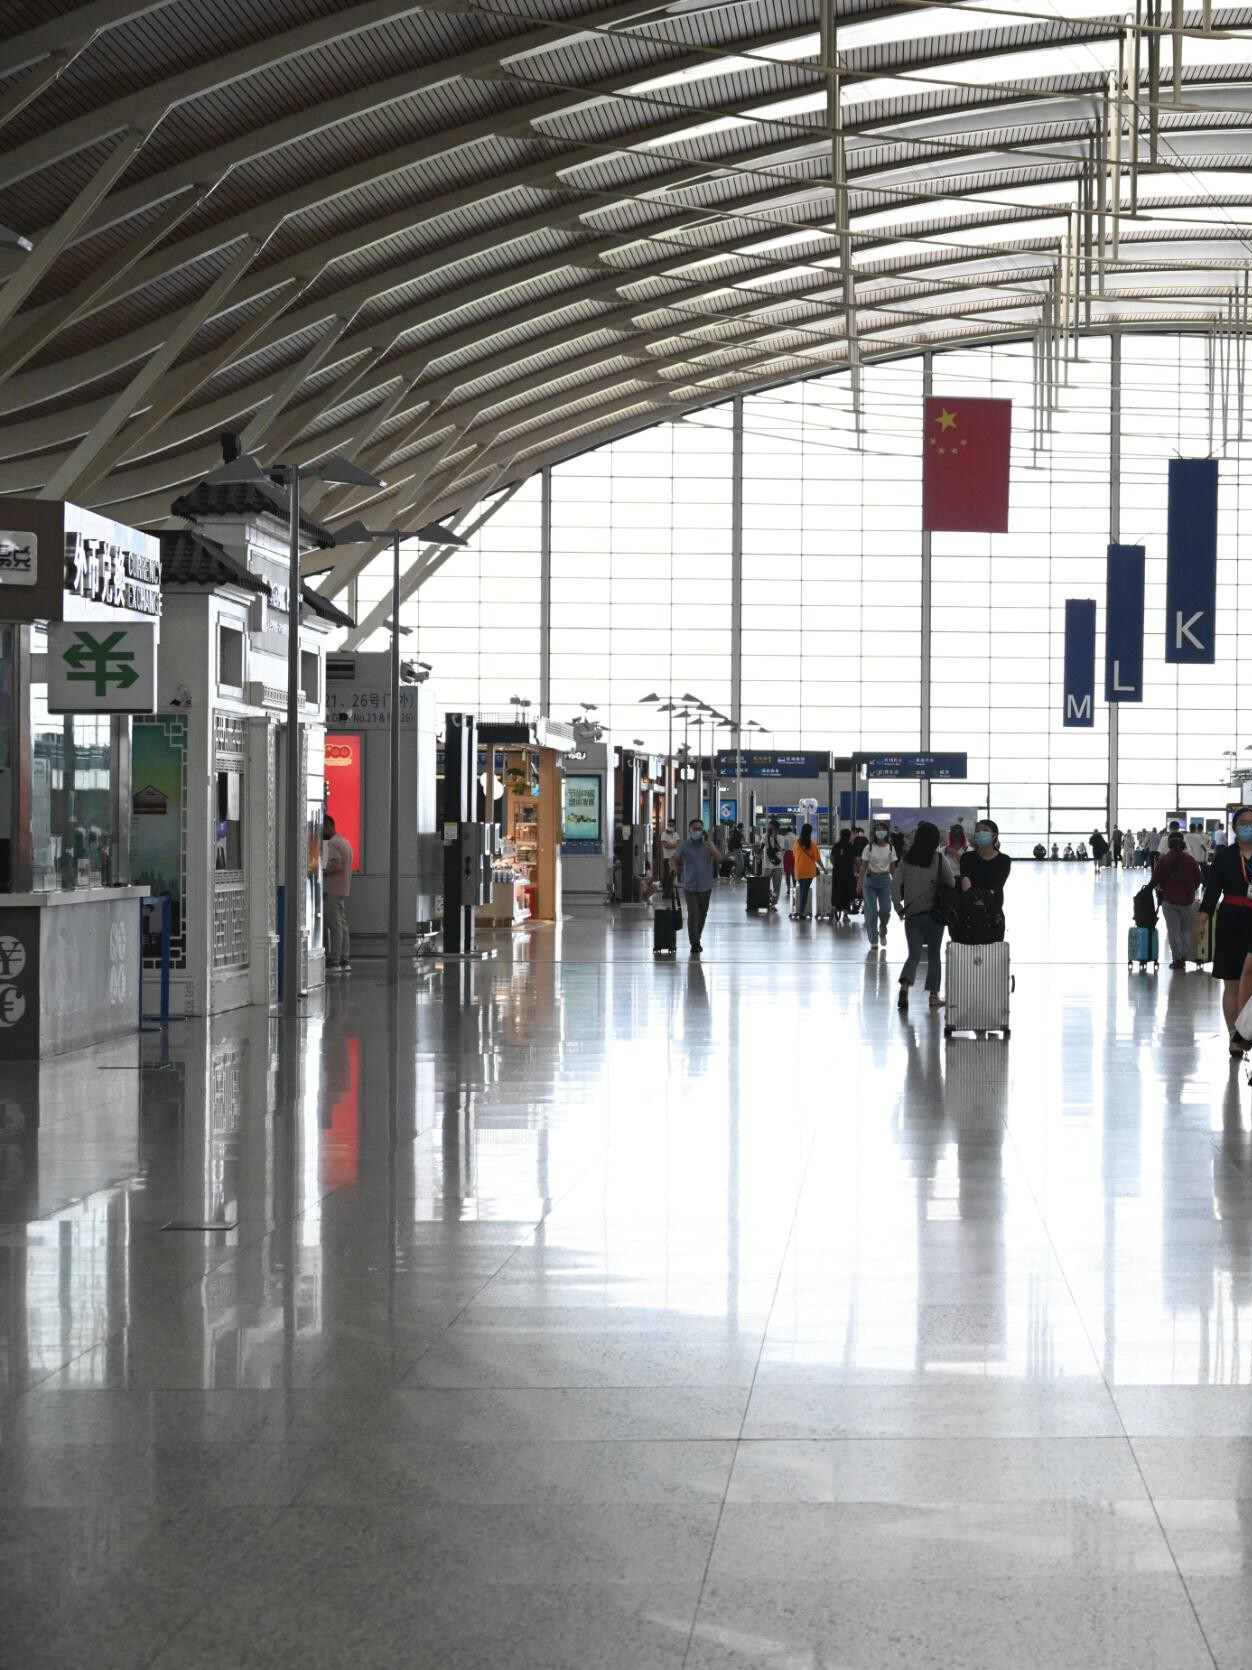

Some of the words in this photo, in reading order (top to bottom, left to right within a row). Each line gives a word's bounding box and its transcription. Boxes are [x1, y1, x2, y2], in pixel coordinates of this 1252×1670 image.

[74, 532, 125, 607] 外币兑换
[128, 551, 163, 585] CURRENCY
[128, 583, 163, 616] EXCHANGE
[1176, 611, 1205, 650] K
[1113, 660, 1135, 692] L
[1067, 694, 1092, 719] M
